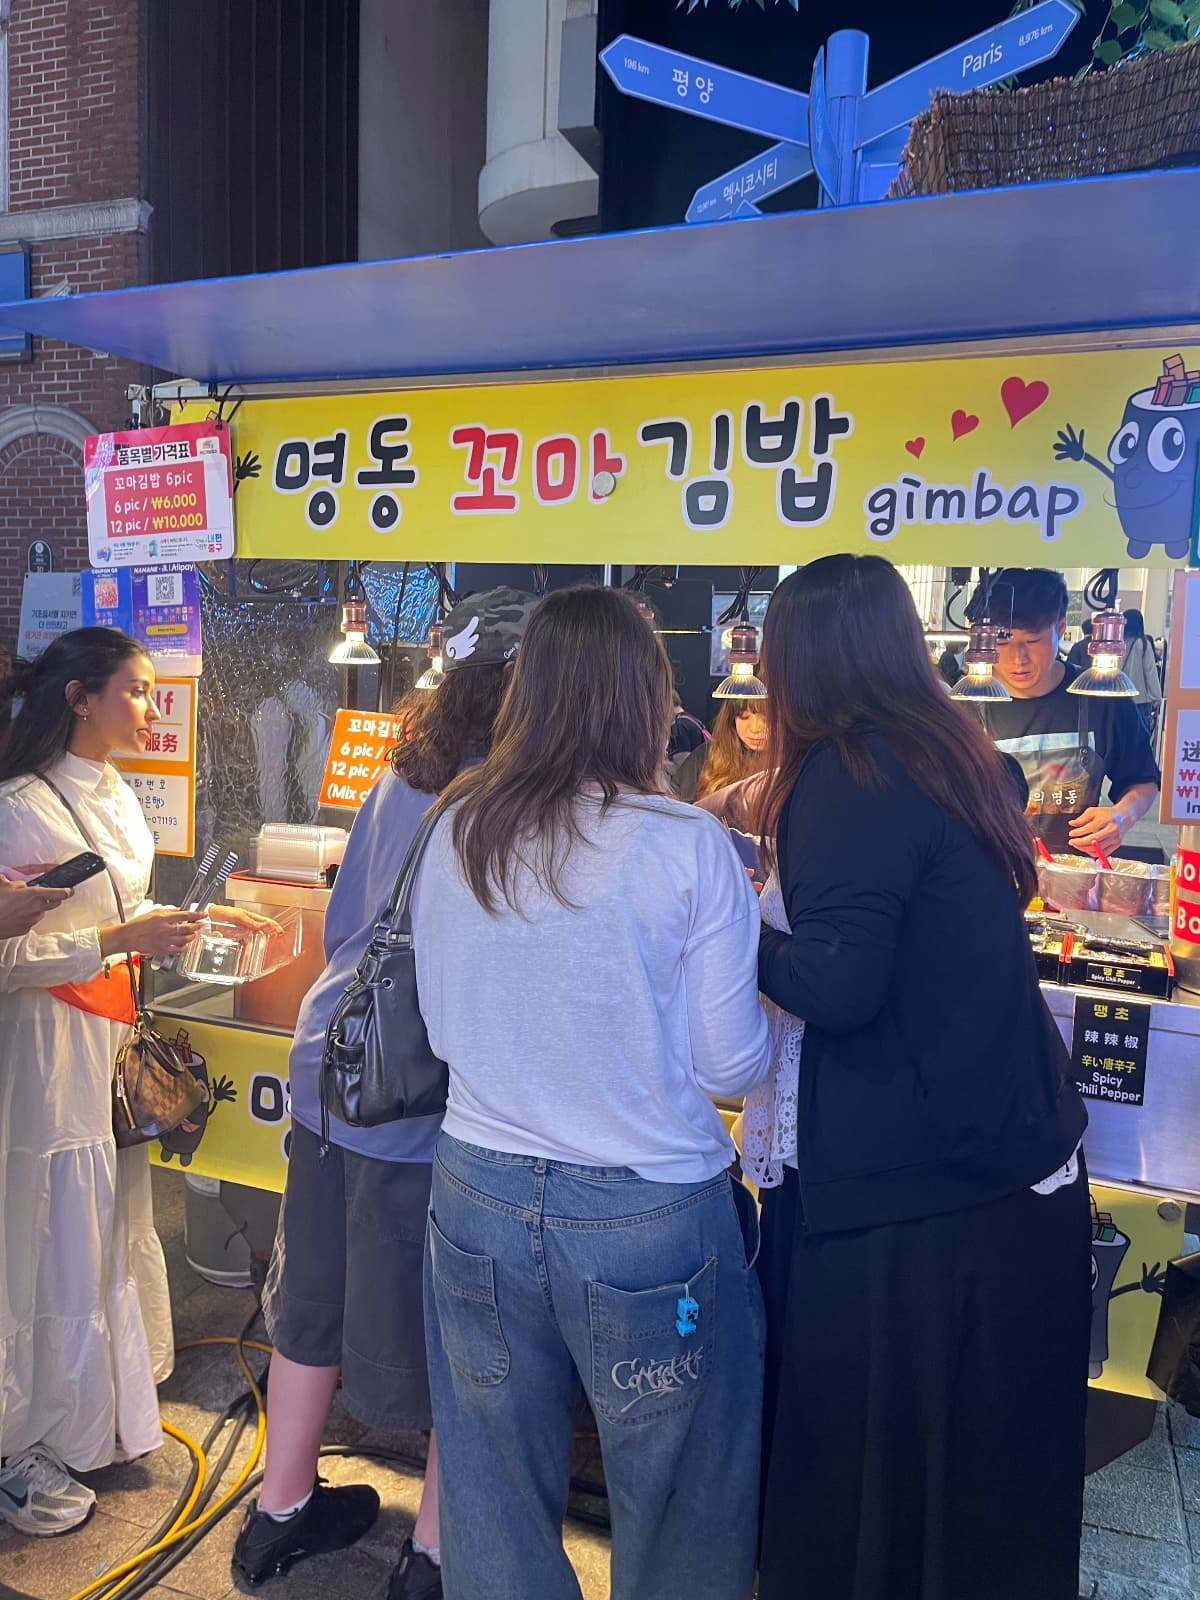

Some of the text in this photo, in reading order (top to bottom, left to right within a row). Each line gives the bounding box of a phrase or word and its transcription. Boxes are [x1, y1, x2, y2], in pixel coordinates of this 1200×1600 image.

[638, 60, 650, 75] km
[962, 43, 1003, 78] Paris
[723, 158, 778, 205] 멕시코시티
[119, 446, 153, 466] 품목별
[155, 442, 190, 461] 가격표
[451, 425, 624, 512] 꼬마
[641, 396, 851, 525] 김밥
[114, 470, 193, 490] 꼬마김밥 6pic
[114, 500, 122, 514] 6
[124, 499, 140, 515] pic
[866, 475, 1081, 539] gimbap
[110, 520, 123, 533] 12
[125, 518, 141, 534] pic
[340, 742, 350, 756] 6
[352, 742, 374, 759] pic
[331, 761, 347, 776] 12
[348, 762, 370, 779] pic
[327, 783, 357, 801] (Mix
[1081, 1054, 1137, 1073] 辛い唐辛子
[1092, 1071, 1123, 1088] Spicy
[1100, 1086, 1142, 1102] Pepper
